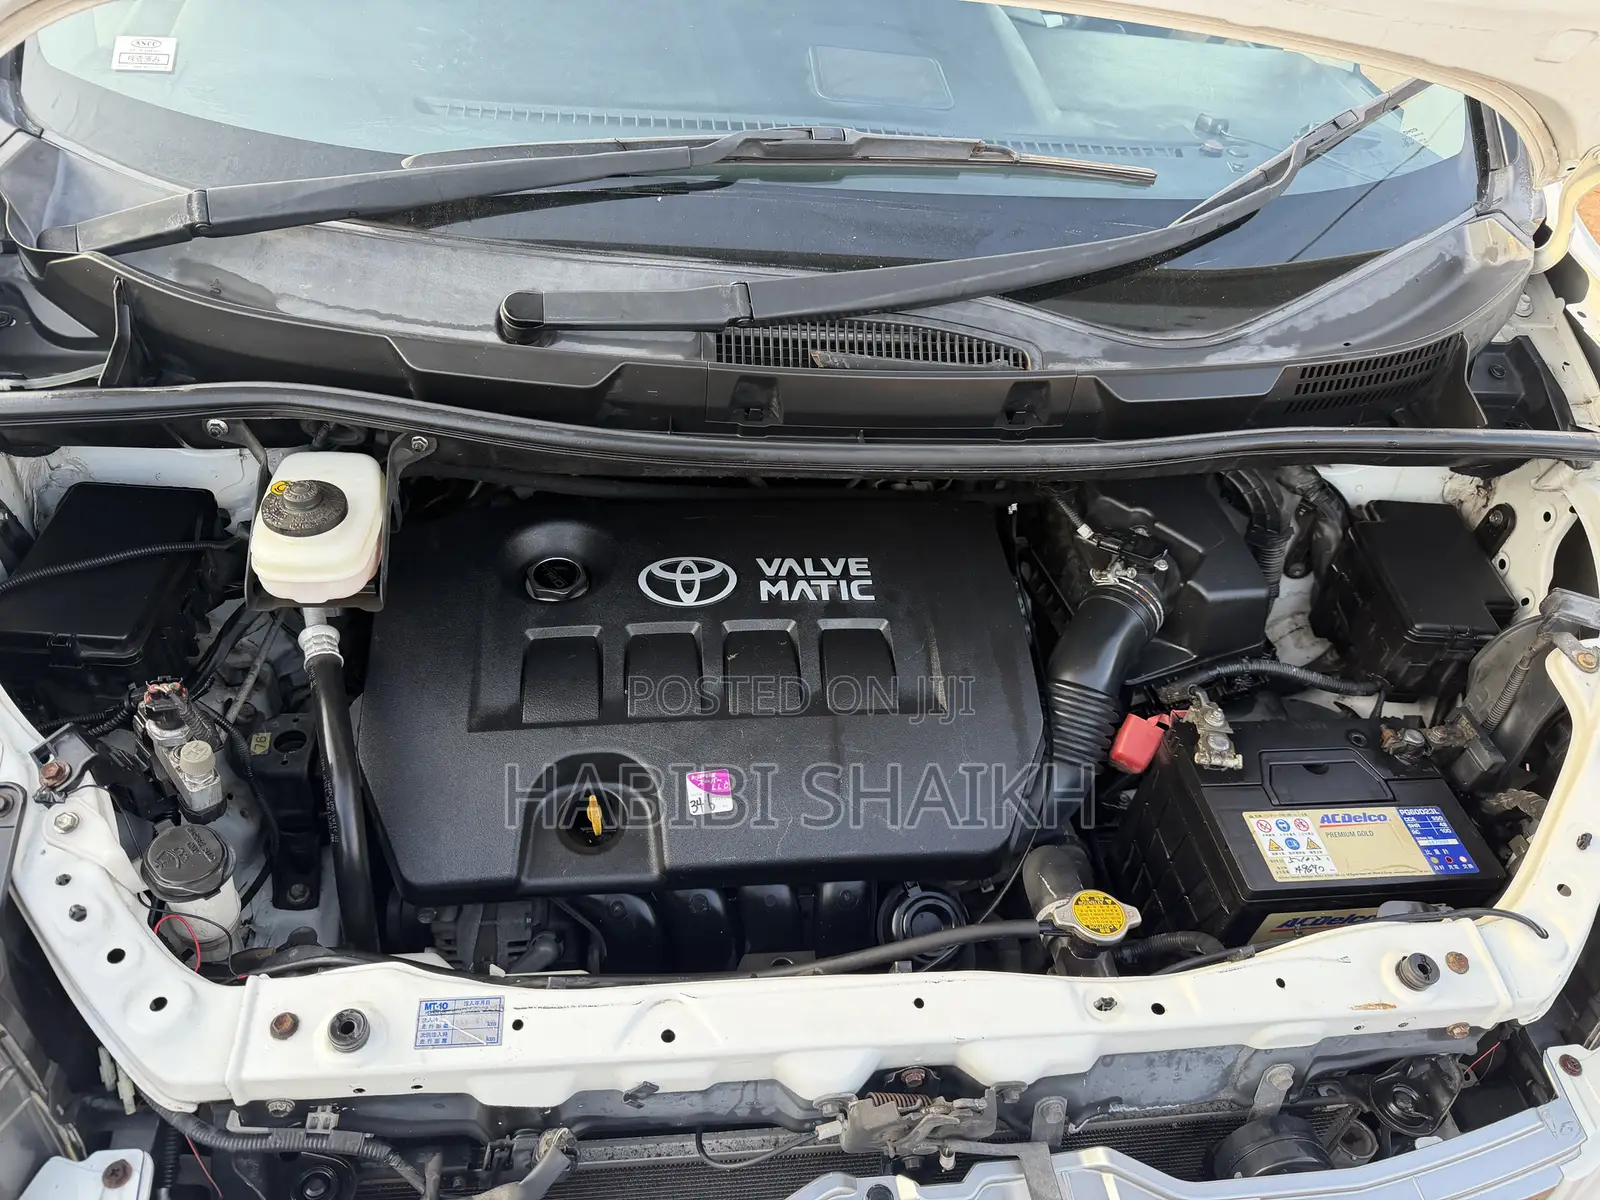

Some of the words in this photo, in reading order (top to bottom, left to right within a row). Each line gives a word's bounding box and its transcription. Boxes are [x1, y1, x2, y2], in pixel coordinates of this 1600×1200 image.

[755, 557, 872, 576] VALVE
[759, 580, 876, 601] MATIC
[1320, 812, 1388, 824] ACDelco
